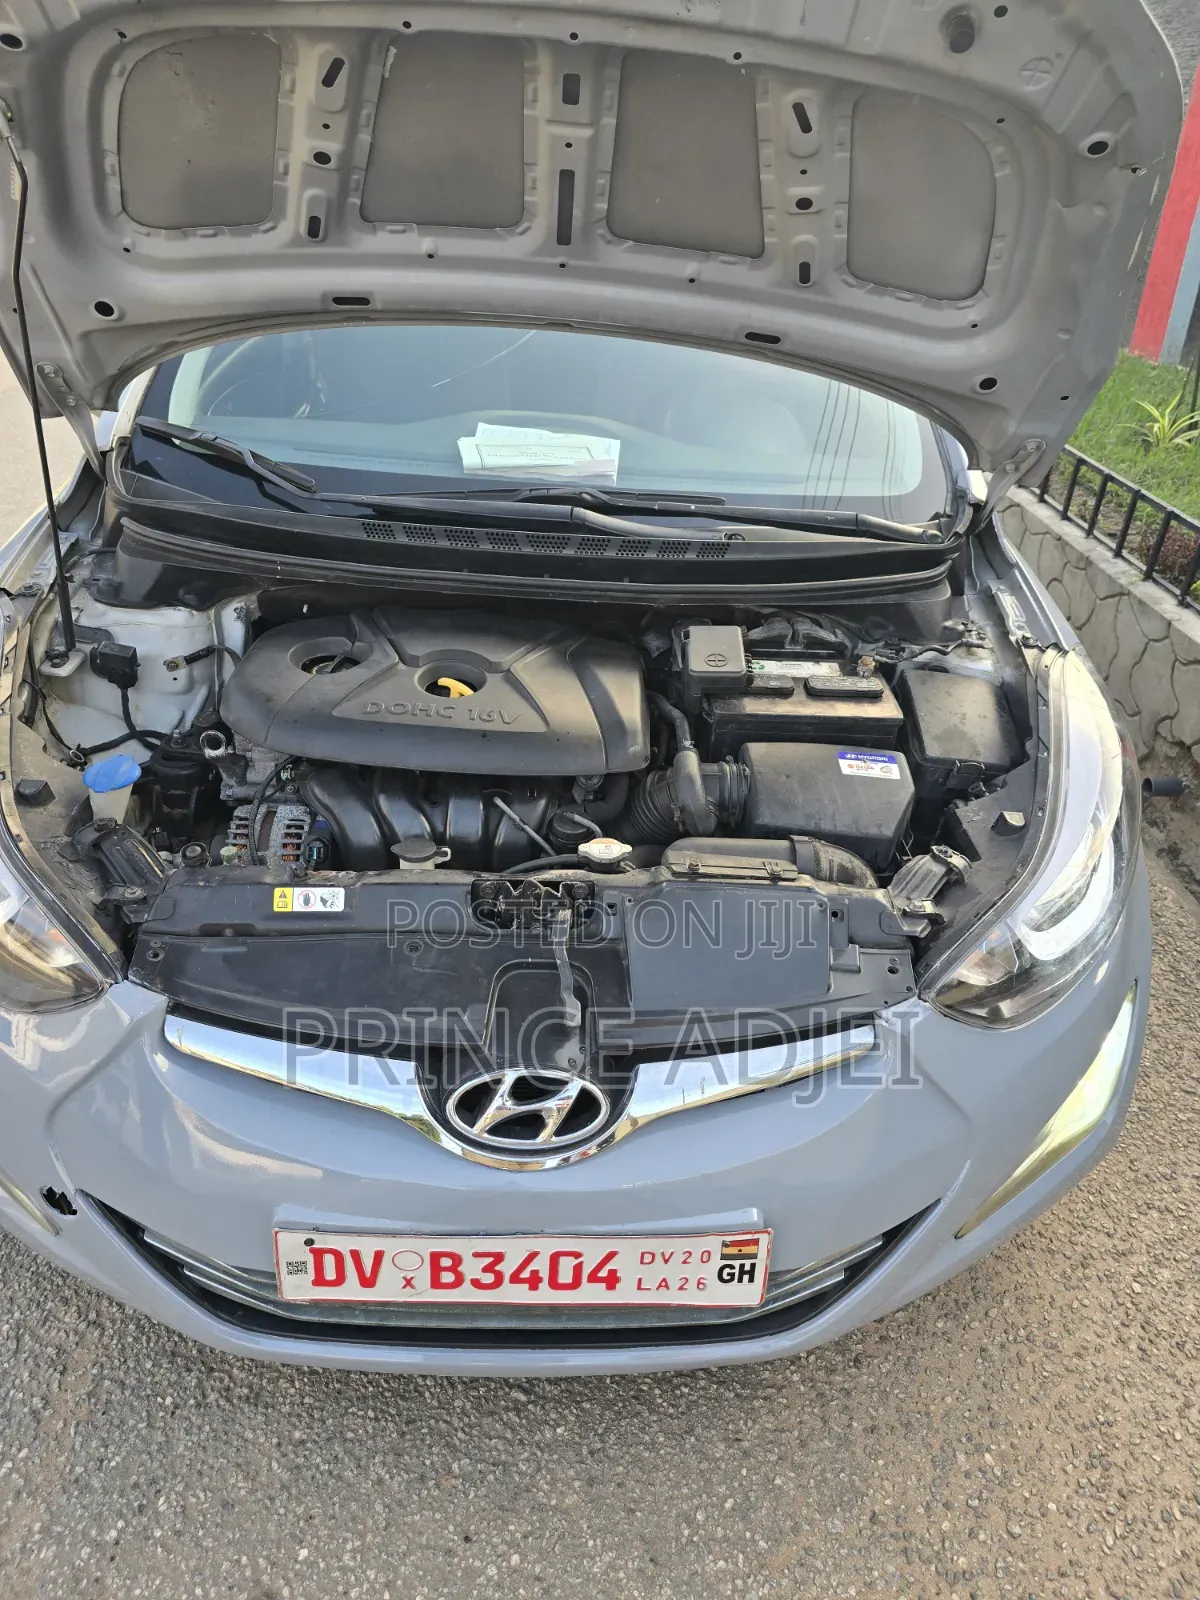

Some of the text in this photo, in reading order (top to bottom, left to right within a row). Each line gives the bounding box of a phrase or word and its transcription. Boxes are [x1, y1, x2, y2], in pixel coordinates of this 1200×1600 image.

[361, 702, 522, 725] DOHC 16V
[308, 1246, 385, 1288] DV
[429, 1250, 622, 1292] B3404
[717, 1262, 757, 1284] GH
